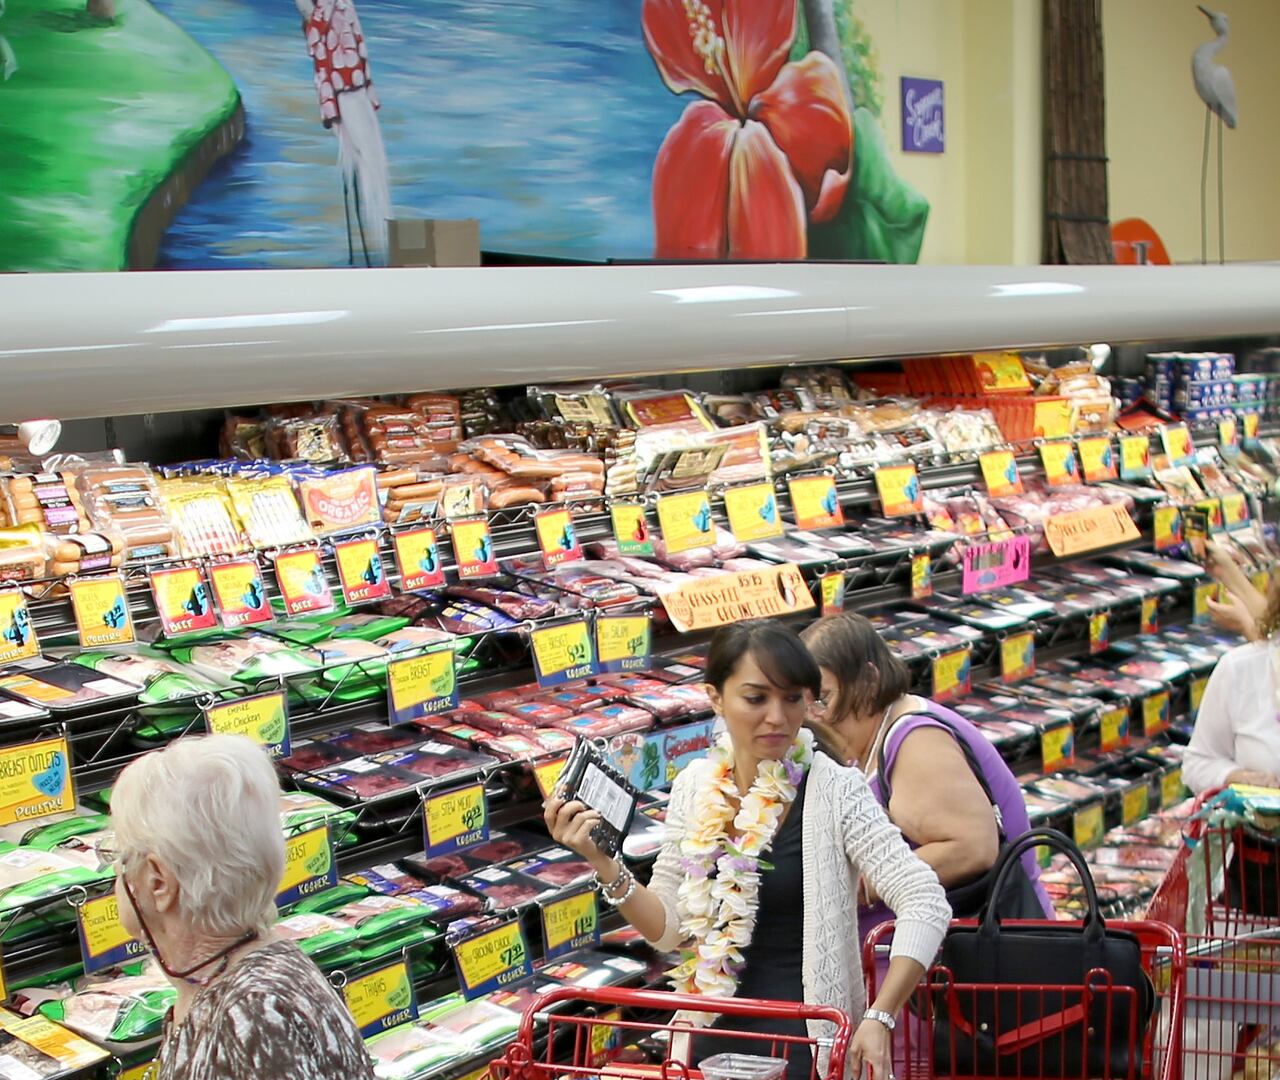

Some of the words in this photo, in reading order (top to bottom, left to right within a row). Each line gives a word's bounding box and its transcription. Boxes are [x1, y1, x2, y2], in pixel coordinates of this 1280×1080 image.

[318, 491, 370, 519] ORGANIC
[548, 552, 566, 564] BEEF
[463, 564, 480, 576] BEEF
[406, 577, 425, 589] BEEF
[348, 588, 369, 601] BEEF
[290, 600, 313, 613] BEEF
[170, 618, 193, 633] BEEF
[227, 613, 251, 625] BEEF
[85, 632, 121, 646] POULTRY
[621, 658, 645, 669] KOSHER
[410, 663, 432, 681] BREAST
[566, 664, 593, 679] KOSHER
[227, 702, 251, 716] EMPIRE
[423, 697, 454, 712] KOSHER
[233, 713, 261, 727] Chicken
[28, 750, 61, 773] CUTLETS
[14, 797, 64, 822] POULTRY
[440, 800, 456, 816] STEW
[455, 830, 483, 847] KOSHER
[284, 842, 307, 864] REAST
[297, 875, 330, 895] KOSHER
[570, 935, 596, 949] KOSHER
[496, 966, 527, 985] KOSHER
[381, 1009, 412, 1028] KOSHER
